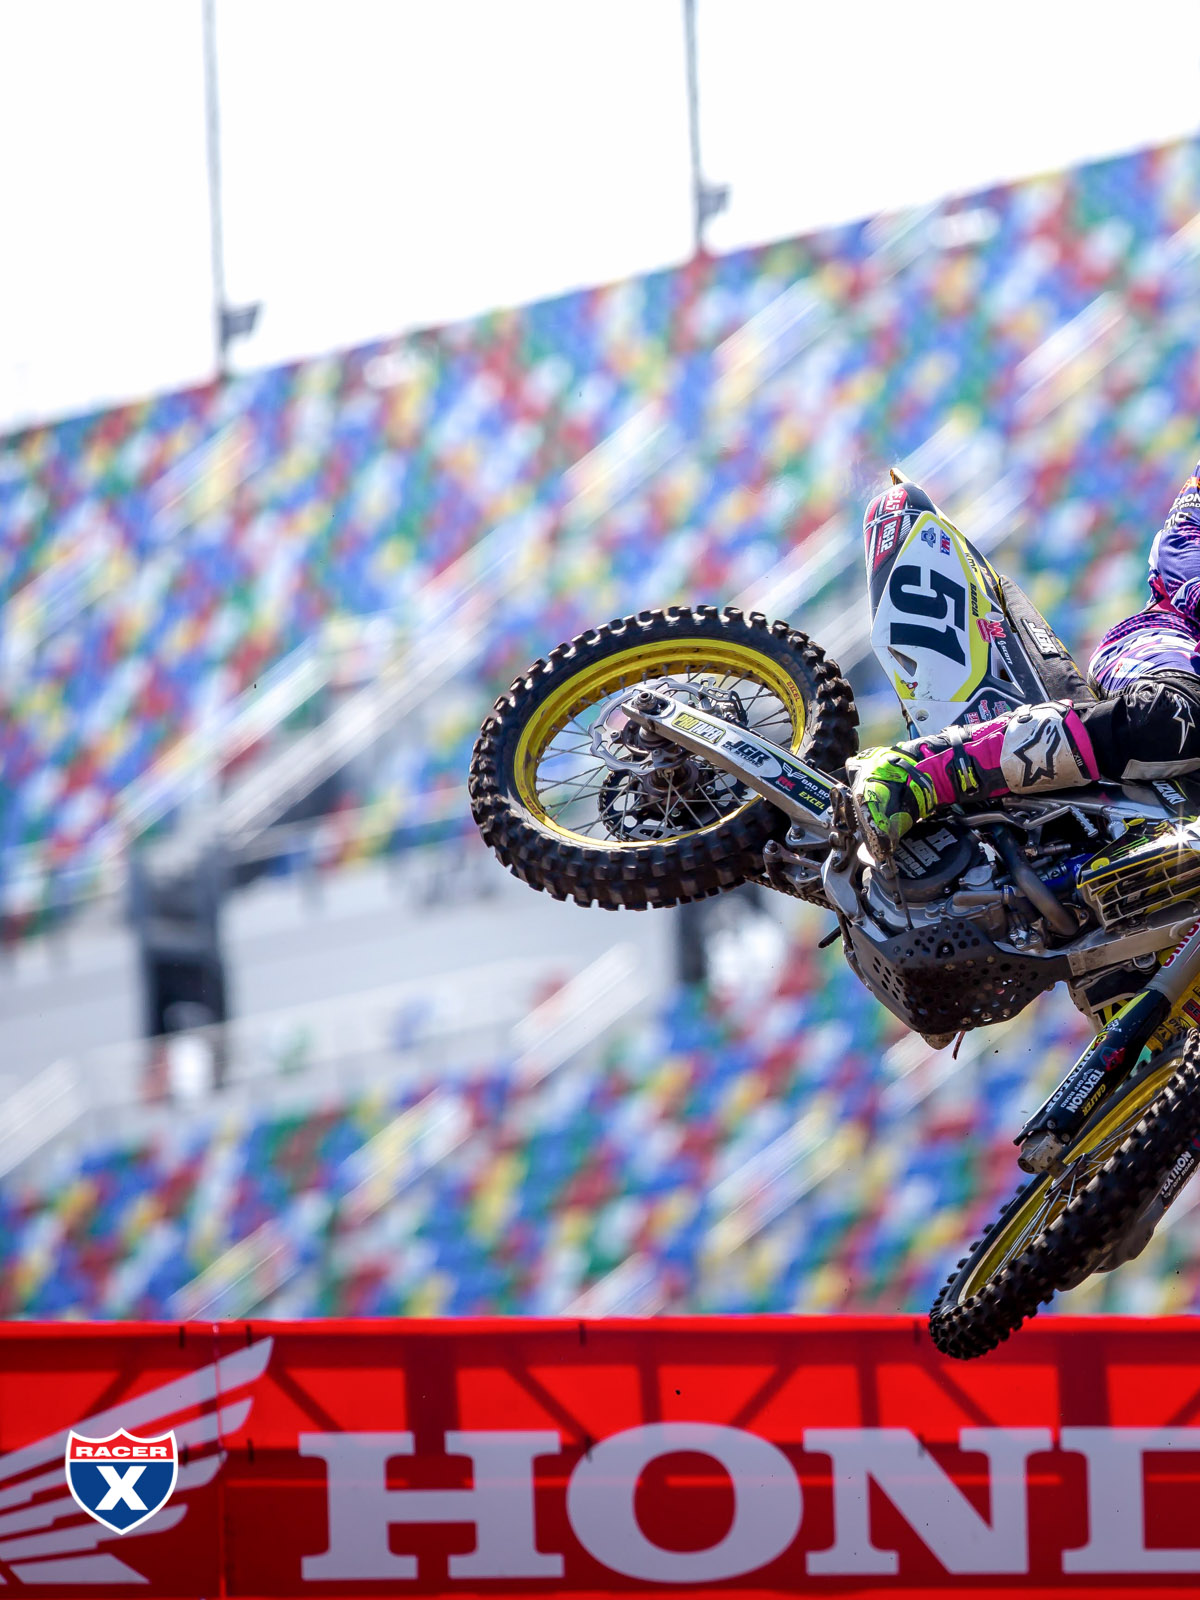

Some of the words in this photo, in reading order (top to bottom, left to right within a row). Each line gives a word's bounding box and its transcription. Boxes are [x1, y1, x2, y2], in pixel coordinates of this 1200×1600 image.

[889, 564, 966, 667] 51
[1028, 622, 1060, 655] JGR
[726, 740, 772, 764] JGR
[798, 791, 825, 810] EXCEL
[801, 778, 819, 791] BAD
[818, 788, 830, 799] BO
[1151, 780, 1187, 805] UZUKI
[1045, 1049, 1096, 1113] DUNLOP
[1066, 1069, 1106, 1113] TEXTRON
[1074, 1080, 1085, 1092] OFF
[1060, 1091, 1076, 1108] ROAD
[1081, 1083, 1107, 1117] GALFER
[1181, 1158, 1195, 1176] ROAD
